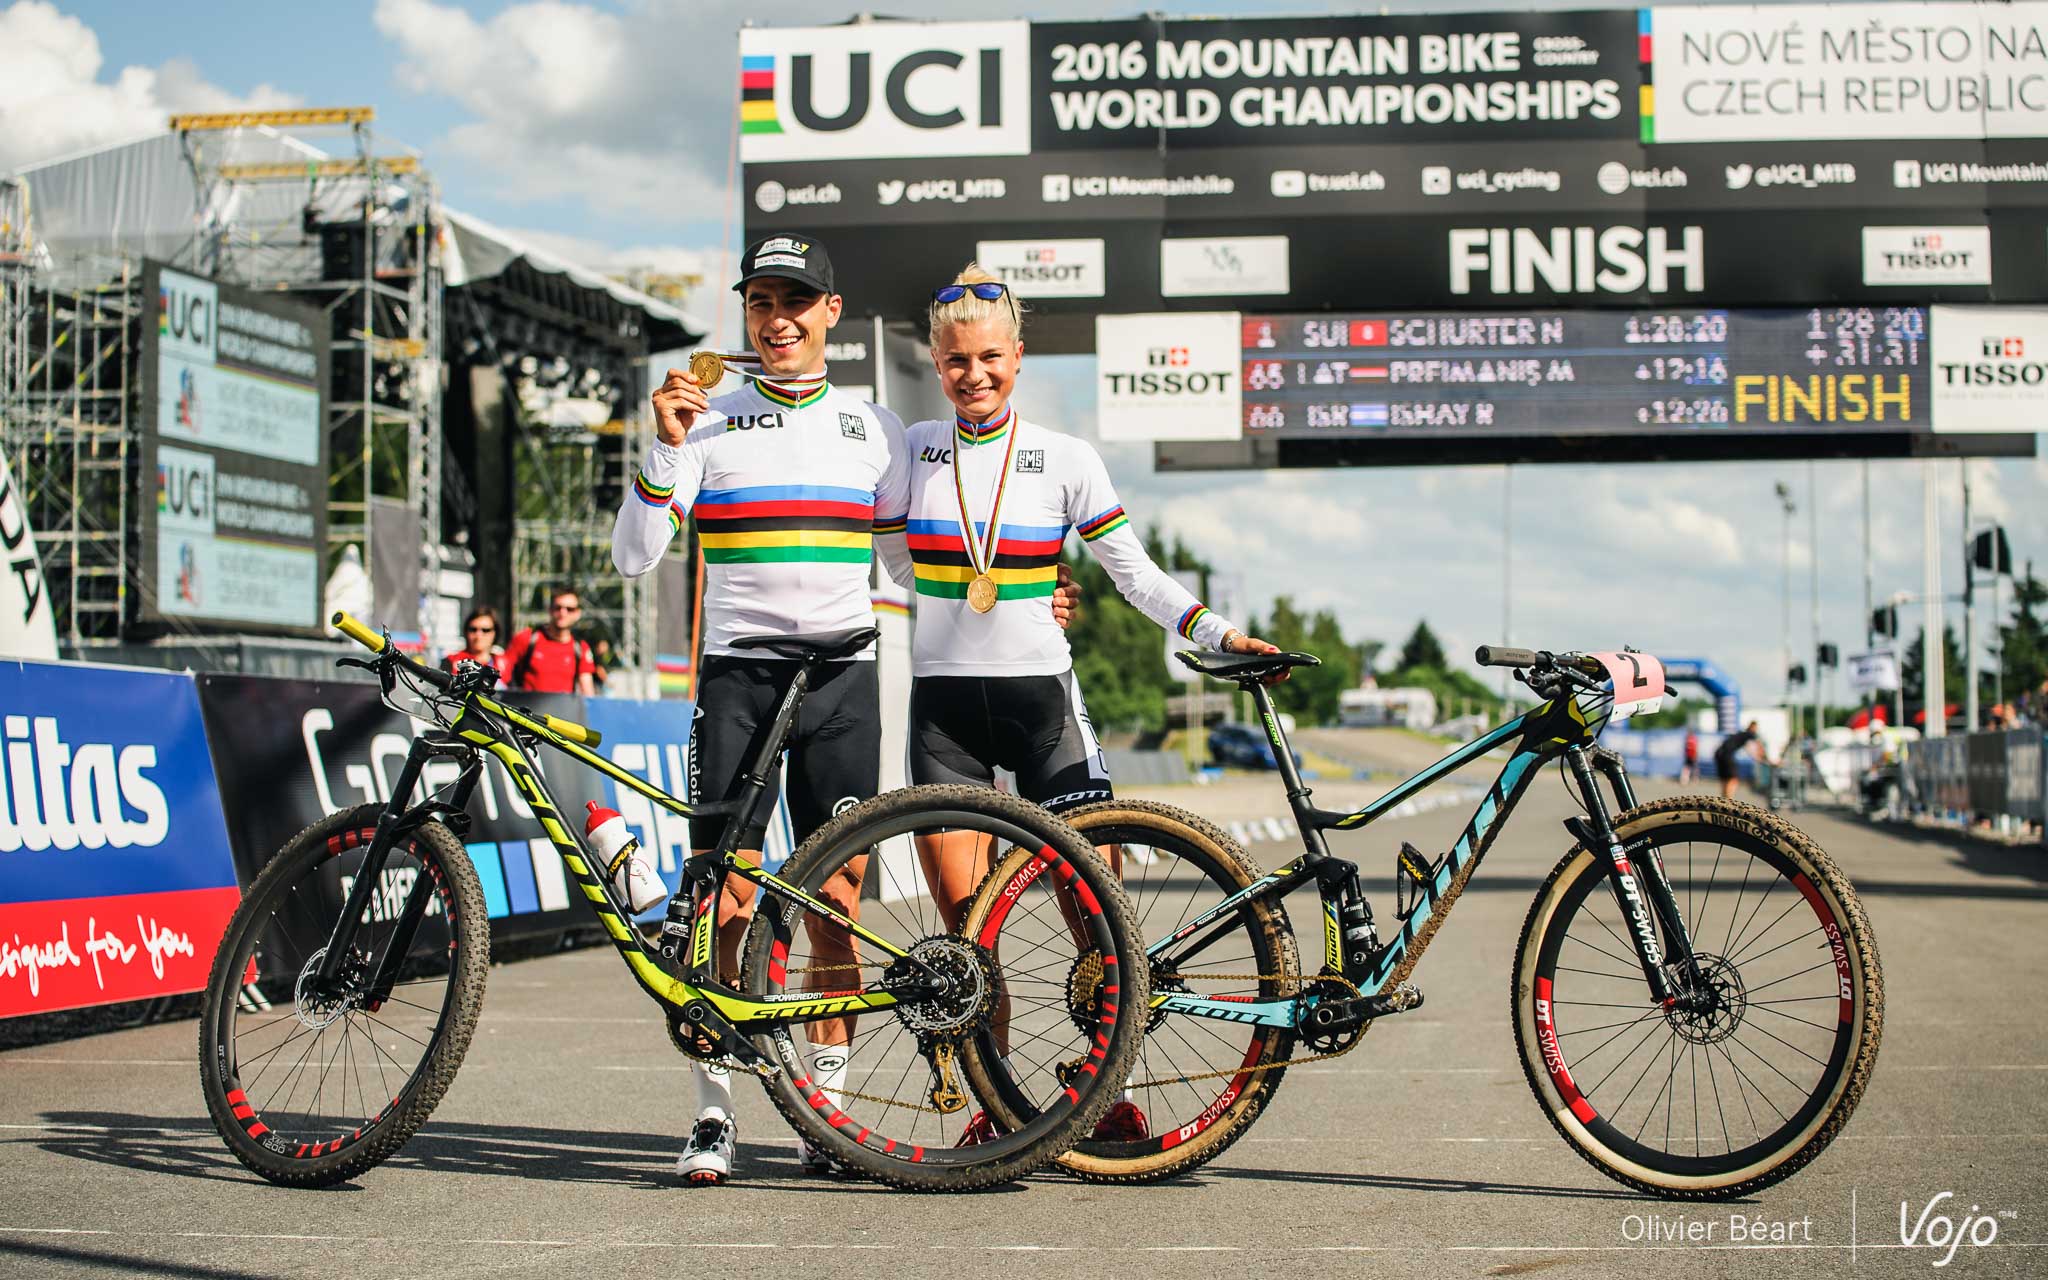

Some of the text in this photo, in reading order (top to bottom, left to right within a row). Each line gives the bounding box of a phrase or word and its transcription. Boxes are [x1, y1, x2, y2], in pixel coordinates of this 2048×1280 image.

[1051, 31, 1521, 81] 2016 MOUNTAIN BIKE
[1532, 50, 1600, 66] COUNTRY
[1683, 19, 2048, 67] NOVÉ MĚSTO NA
[790, 47, 1001, 132] UCI
[1051, 78, 1622, 131] WORLD CHAMPIONSHIPS
[1682, 73, 2047, 116] CZECH REPUBLIC
[1072, 174, 1235, 197] UCI Mountainbike
[1923, 161, 2048, 183] UCI Mountain
[996, 264, 1085, 282] TISSOT
[1448, 226, 1705, 295] FINISH
[1883, 250, 1974, 269] TISSOT
[169, 287, 211, 346] UCI
[1104, 372, 1233, 395] TISSOT
[1734, 373, 1911, 423] FINISH
[737, 412, 784, 431] UCI
[927, 449, 952, 465] UC
[168, 464, 210, 519] UCI
[1039, 789, 1111, 809] SCOTT
[609, 842, 637, 873] TOPEAK
[1003, 861, 1040, 901] SWISS
[781, 901, 799, 927] SWISS
[1619, 875, 1644, 909] DT
[1632, 909, 1664, 966] SWISS
[85, 916, 137, 991] for
[136, 914, 195, 981] You
[1825, 922, 1849, 969] SWISS
[772, 993, 813, 1003] POWERED
[1839, 973, 1852, 1001] DT
[750, 999, 859, 1020] SCOTT
[1160, 1001, 1271, 1025] SCOTT
[1536, 999, 1564, 1074] DT SWISS
[1179, 1086, 1236, 1141] DT SWISS
[261, 1137, 287, 1155] 1200
